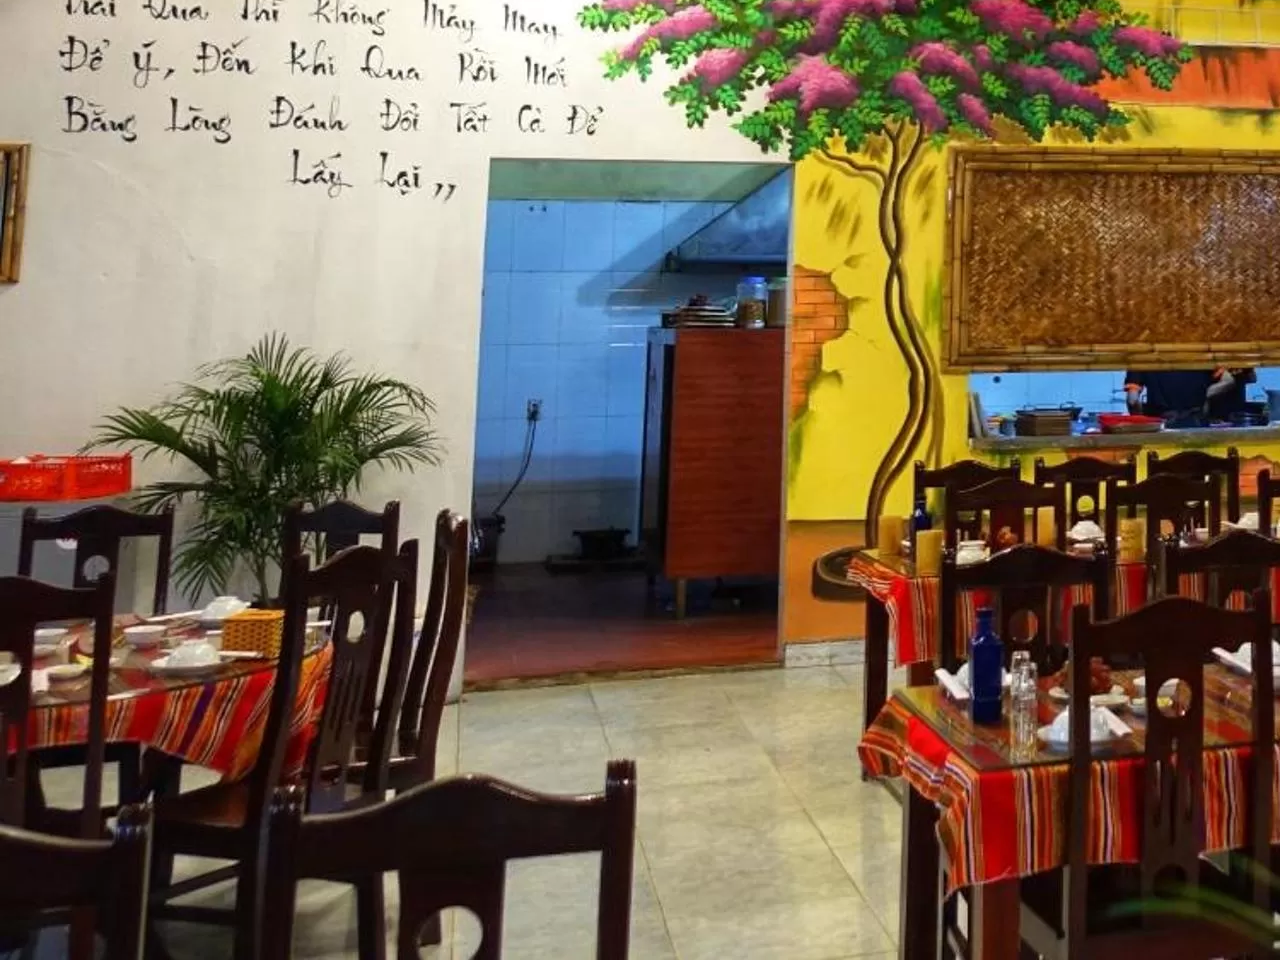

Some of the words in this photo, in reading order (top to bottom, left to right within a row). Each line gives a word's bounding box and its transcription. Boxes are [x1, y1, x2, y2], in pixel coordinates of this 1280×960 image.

[503, 2, 562, 39] May
[59, 36, 110, 73] Để
[193, 38, 258, 76] Đến
[360, 44, 424, 82] Qua
[458, 47, 499, 84] Rồi
[62, 95, 137, 142] Bằng
[164, 97, 232, 144] Lòng
[269, 95, 349, 131] Đánh
[450, 102, 492, 134] Tất
[567, 104, 604, 137] Để
[286, 148, 353, 199] Lấy
